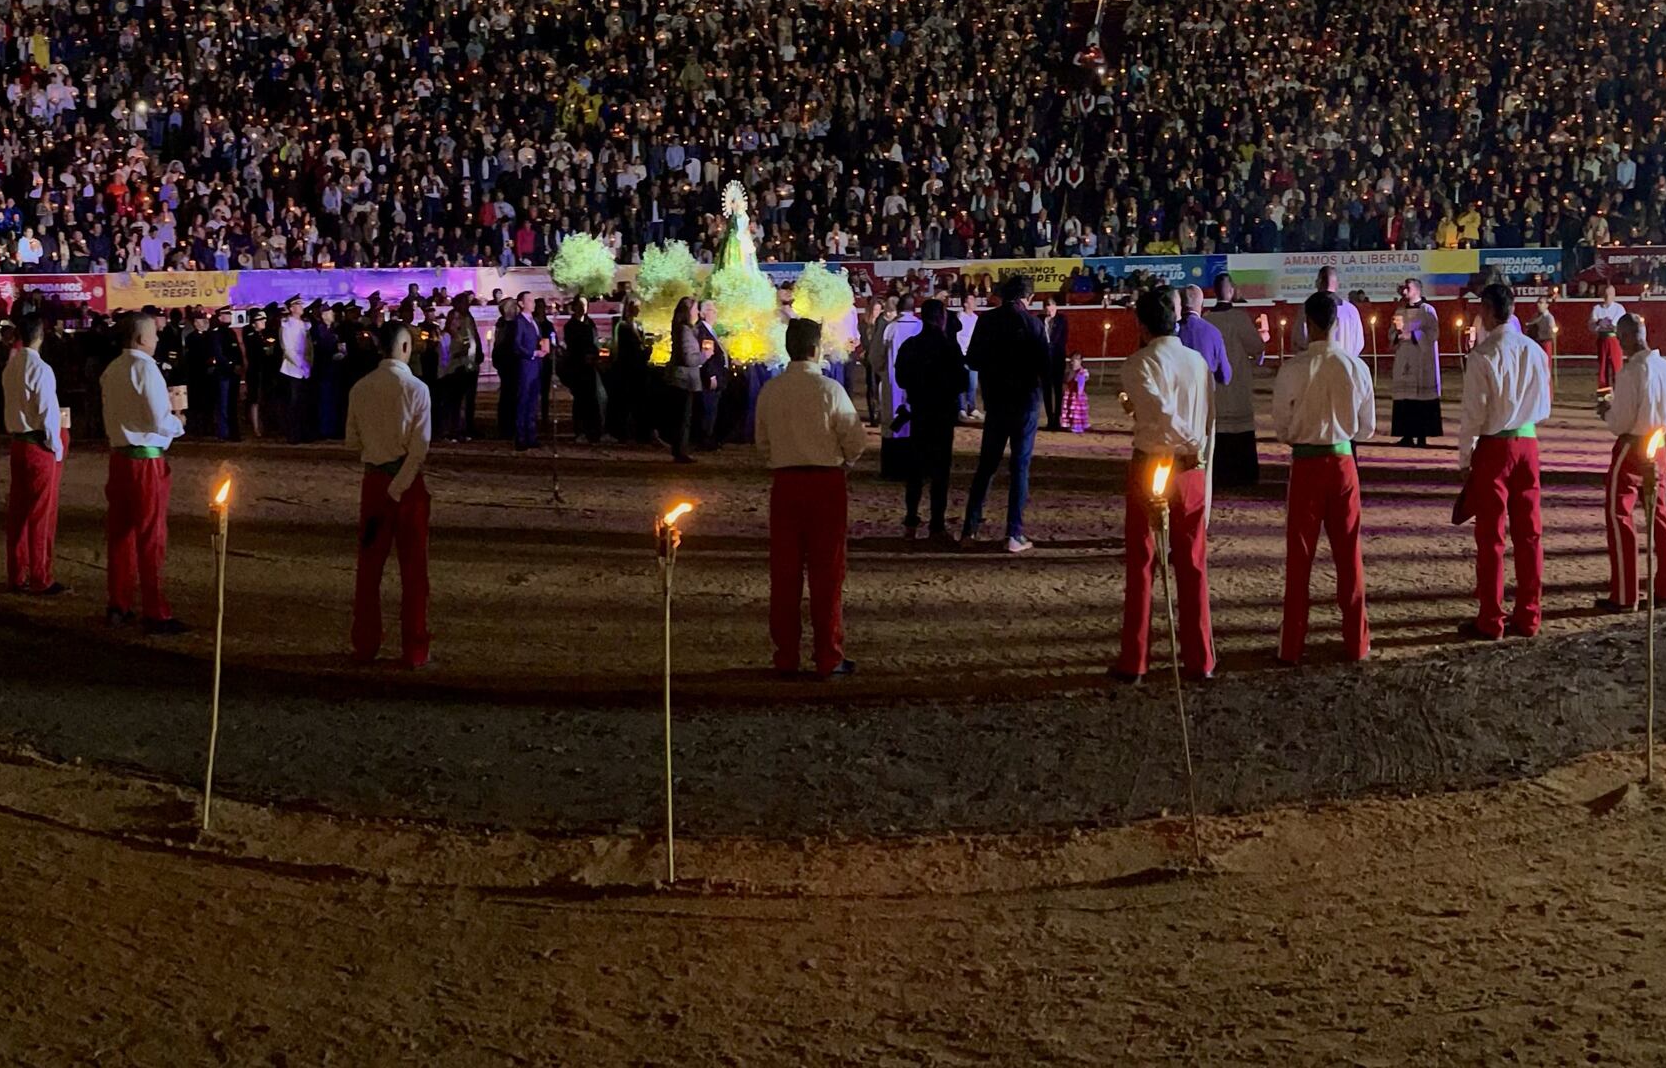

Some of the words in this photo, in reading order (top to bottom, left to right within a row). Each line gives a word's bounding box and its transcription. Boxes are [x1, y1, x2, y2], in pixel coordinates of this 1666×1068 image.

[1284, 255, 1341, 266] AMAMOS
[1341, 254, 1356, 265] LA
[1361, 253, 1419, 264] LIBERTAD
[1504, 264, 1556, 275] EQUIDAD
